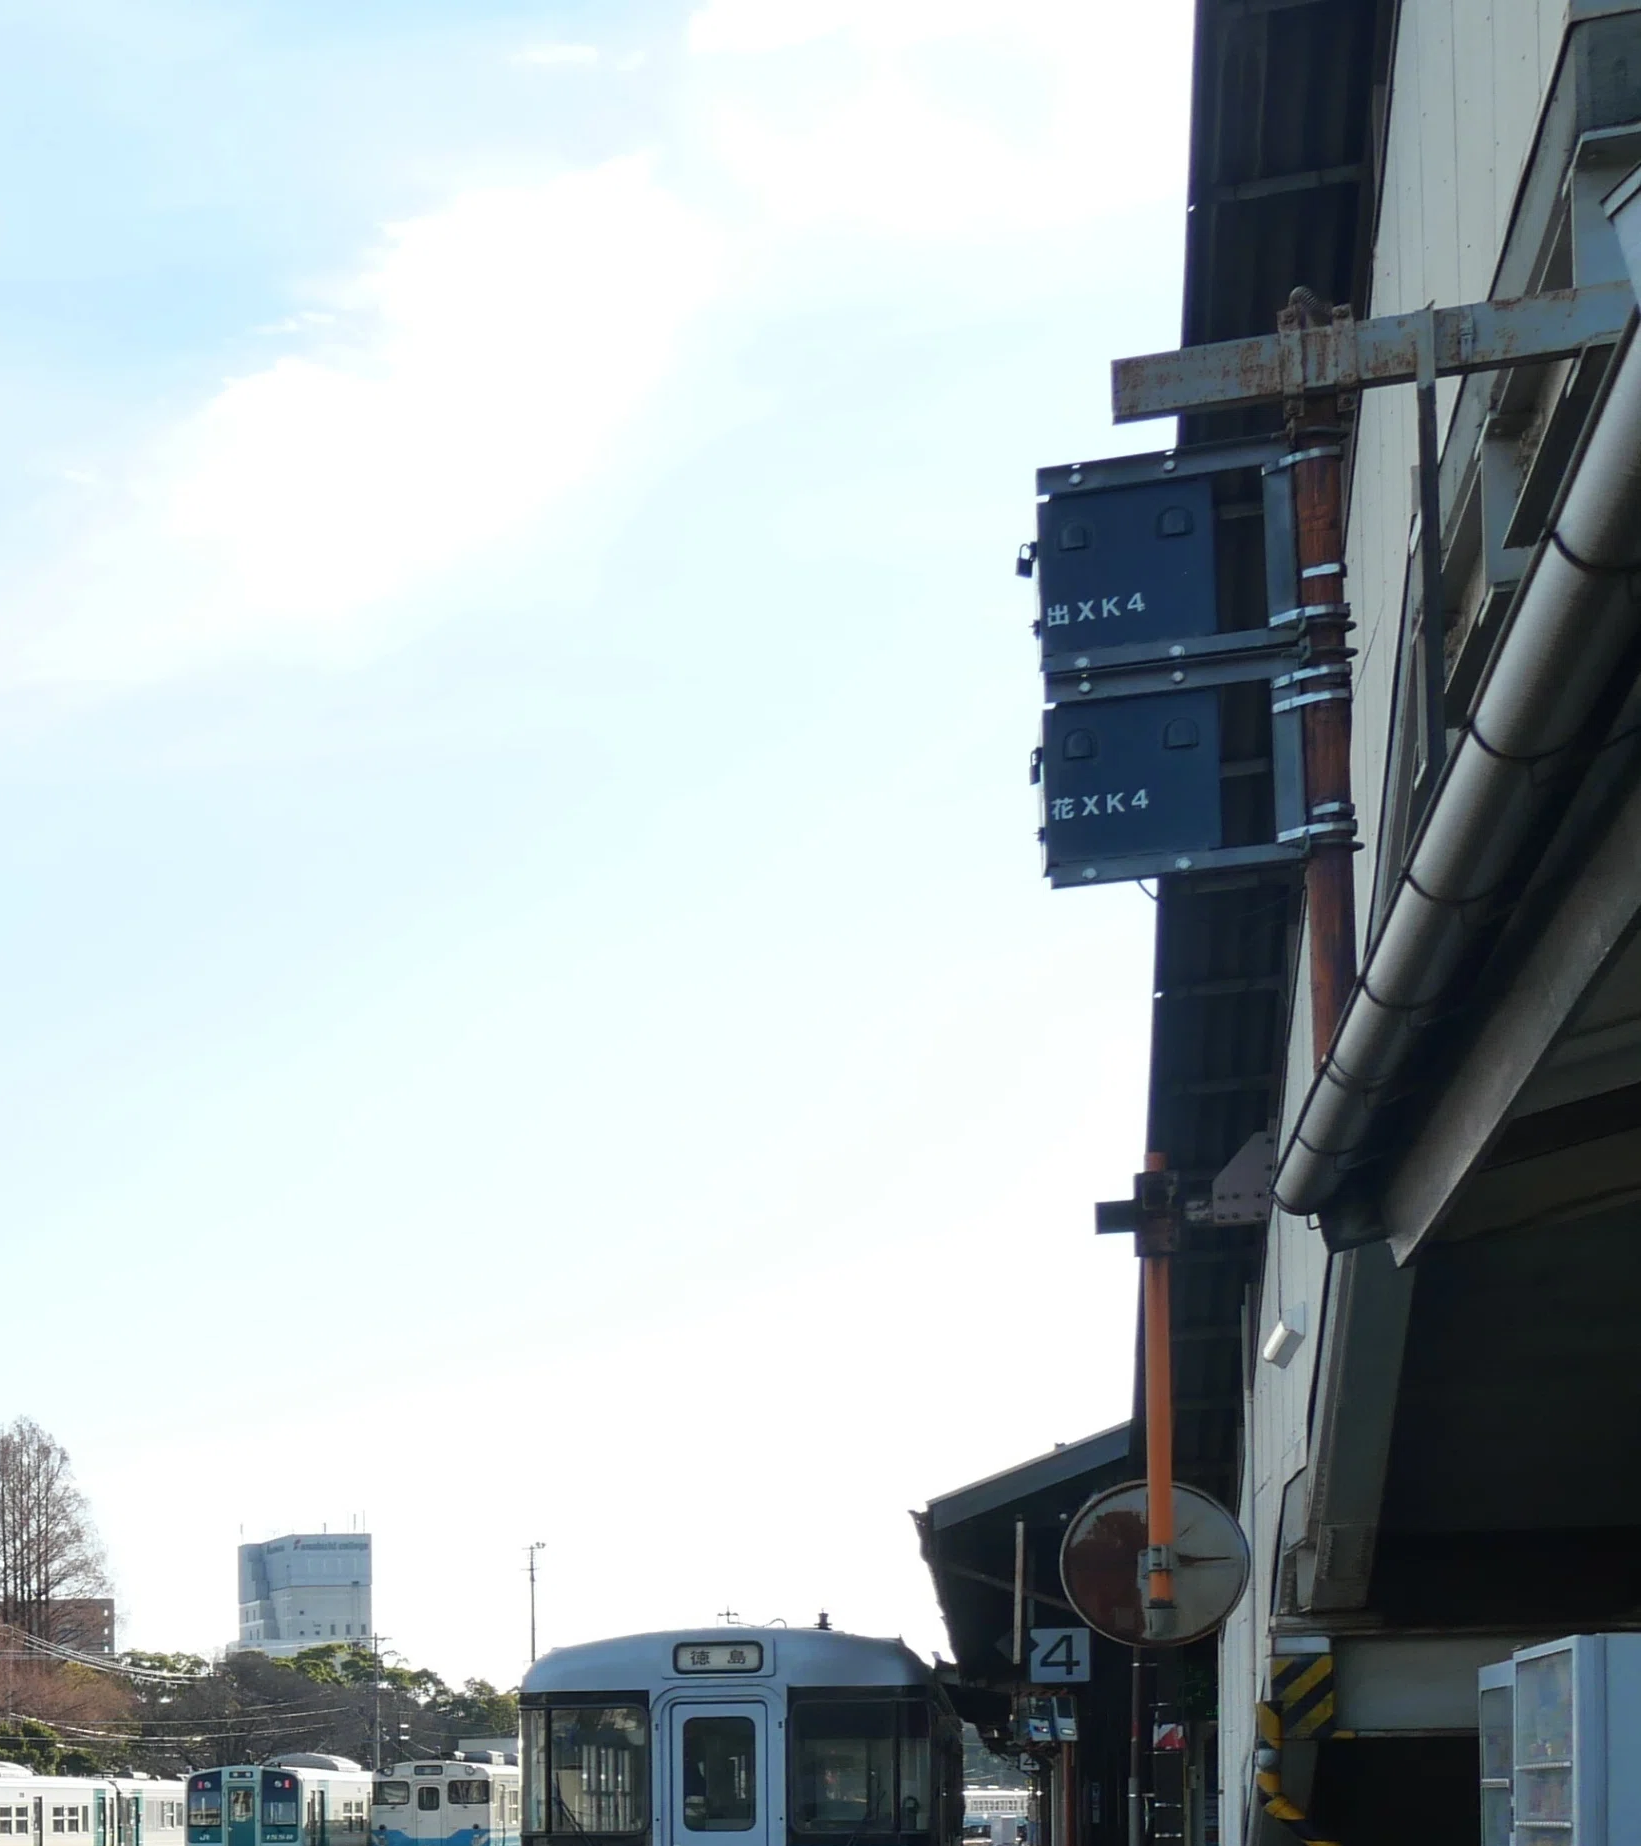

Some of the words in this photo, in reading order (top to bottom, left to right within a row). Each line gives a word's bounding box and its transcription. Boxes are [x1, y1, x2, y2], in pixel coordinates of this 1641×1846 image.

[1047, 592, 1145, 627] 出XK4
[1051, 788, 1149, 820] 花XK4
[690, 1648, 746, 1665] 徳島
[1040, 1634, 1081, 1676] 4
